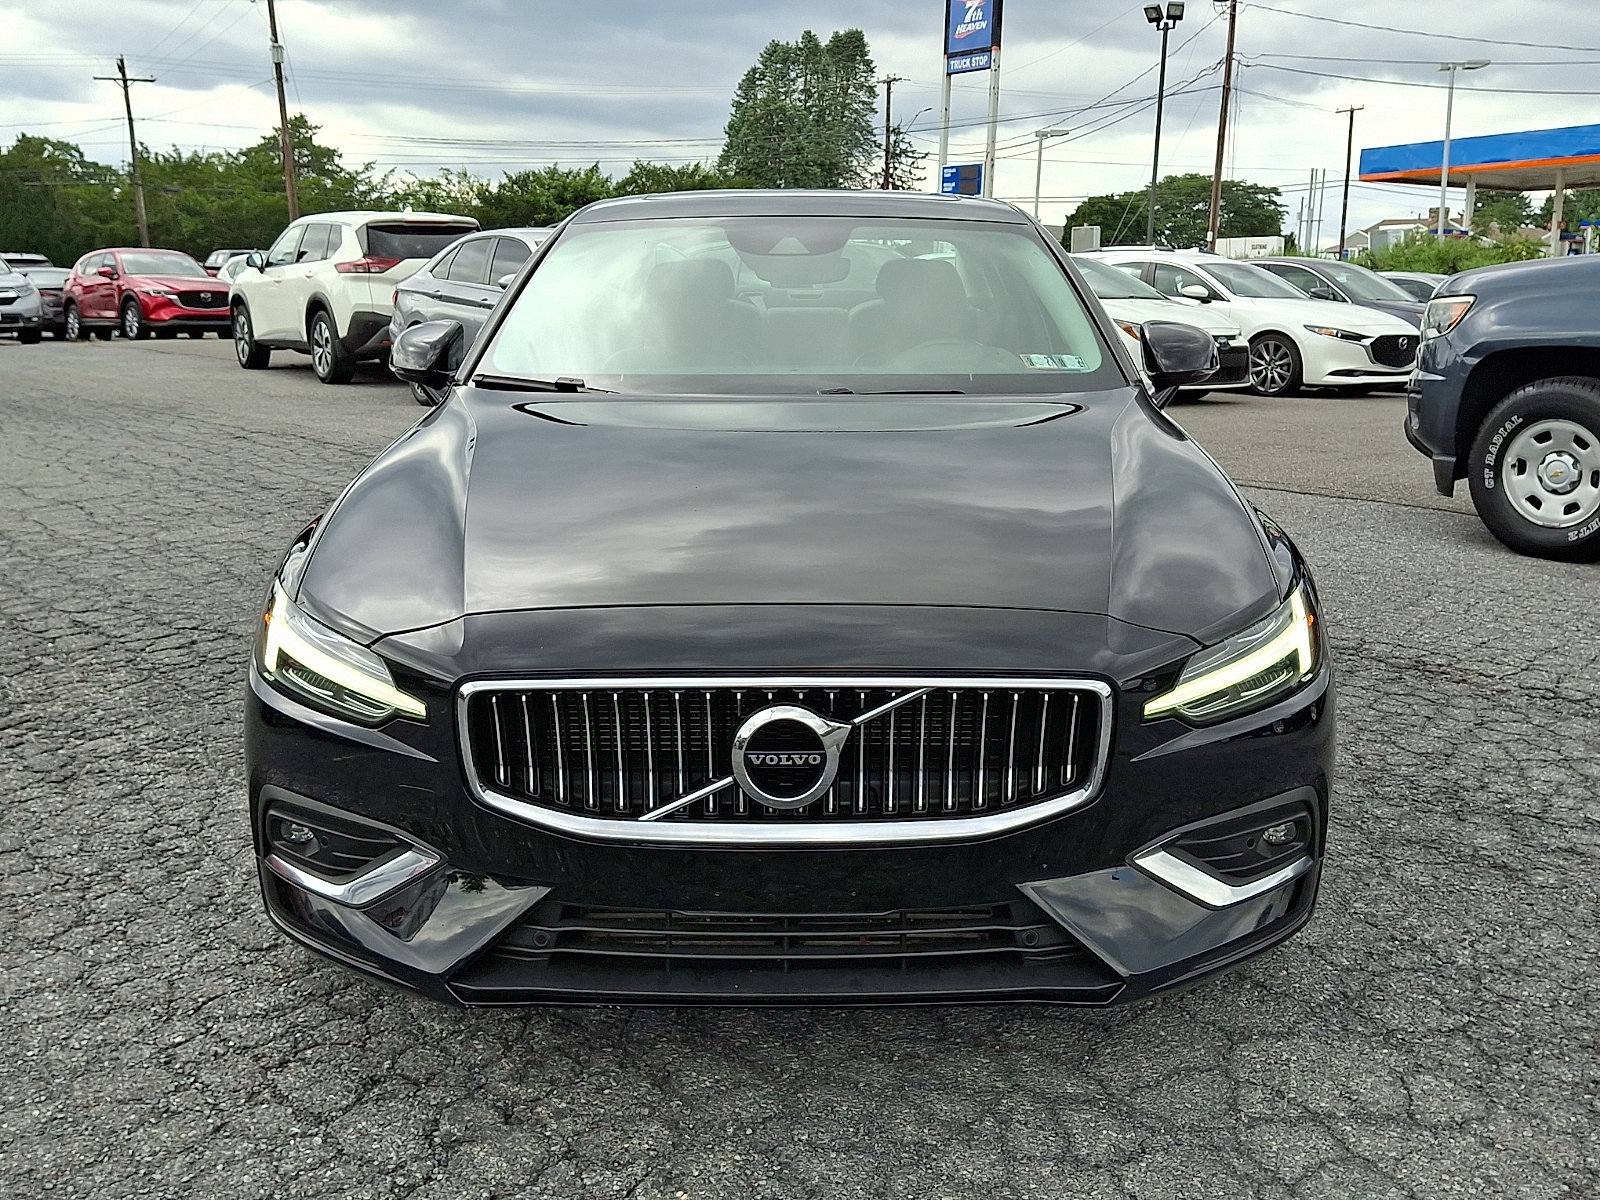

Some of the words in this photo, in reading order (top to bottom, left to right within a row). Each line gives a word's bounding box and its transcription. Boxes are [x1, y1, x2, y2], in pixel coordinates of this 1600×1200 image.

[964, 0, 983, 23] 7th
[955, 20, 988, 35] HEAVEN
[950, 58, 971, 70] TRUCK
[972, 55, 989, 67] STOP
[1485, 415, 1523, 466] RADIAL
[1484, 468, 1495, 488] GT
[748, 755, 821, 765] VOLVO
